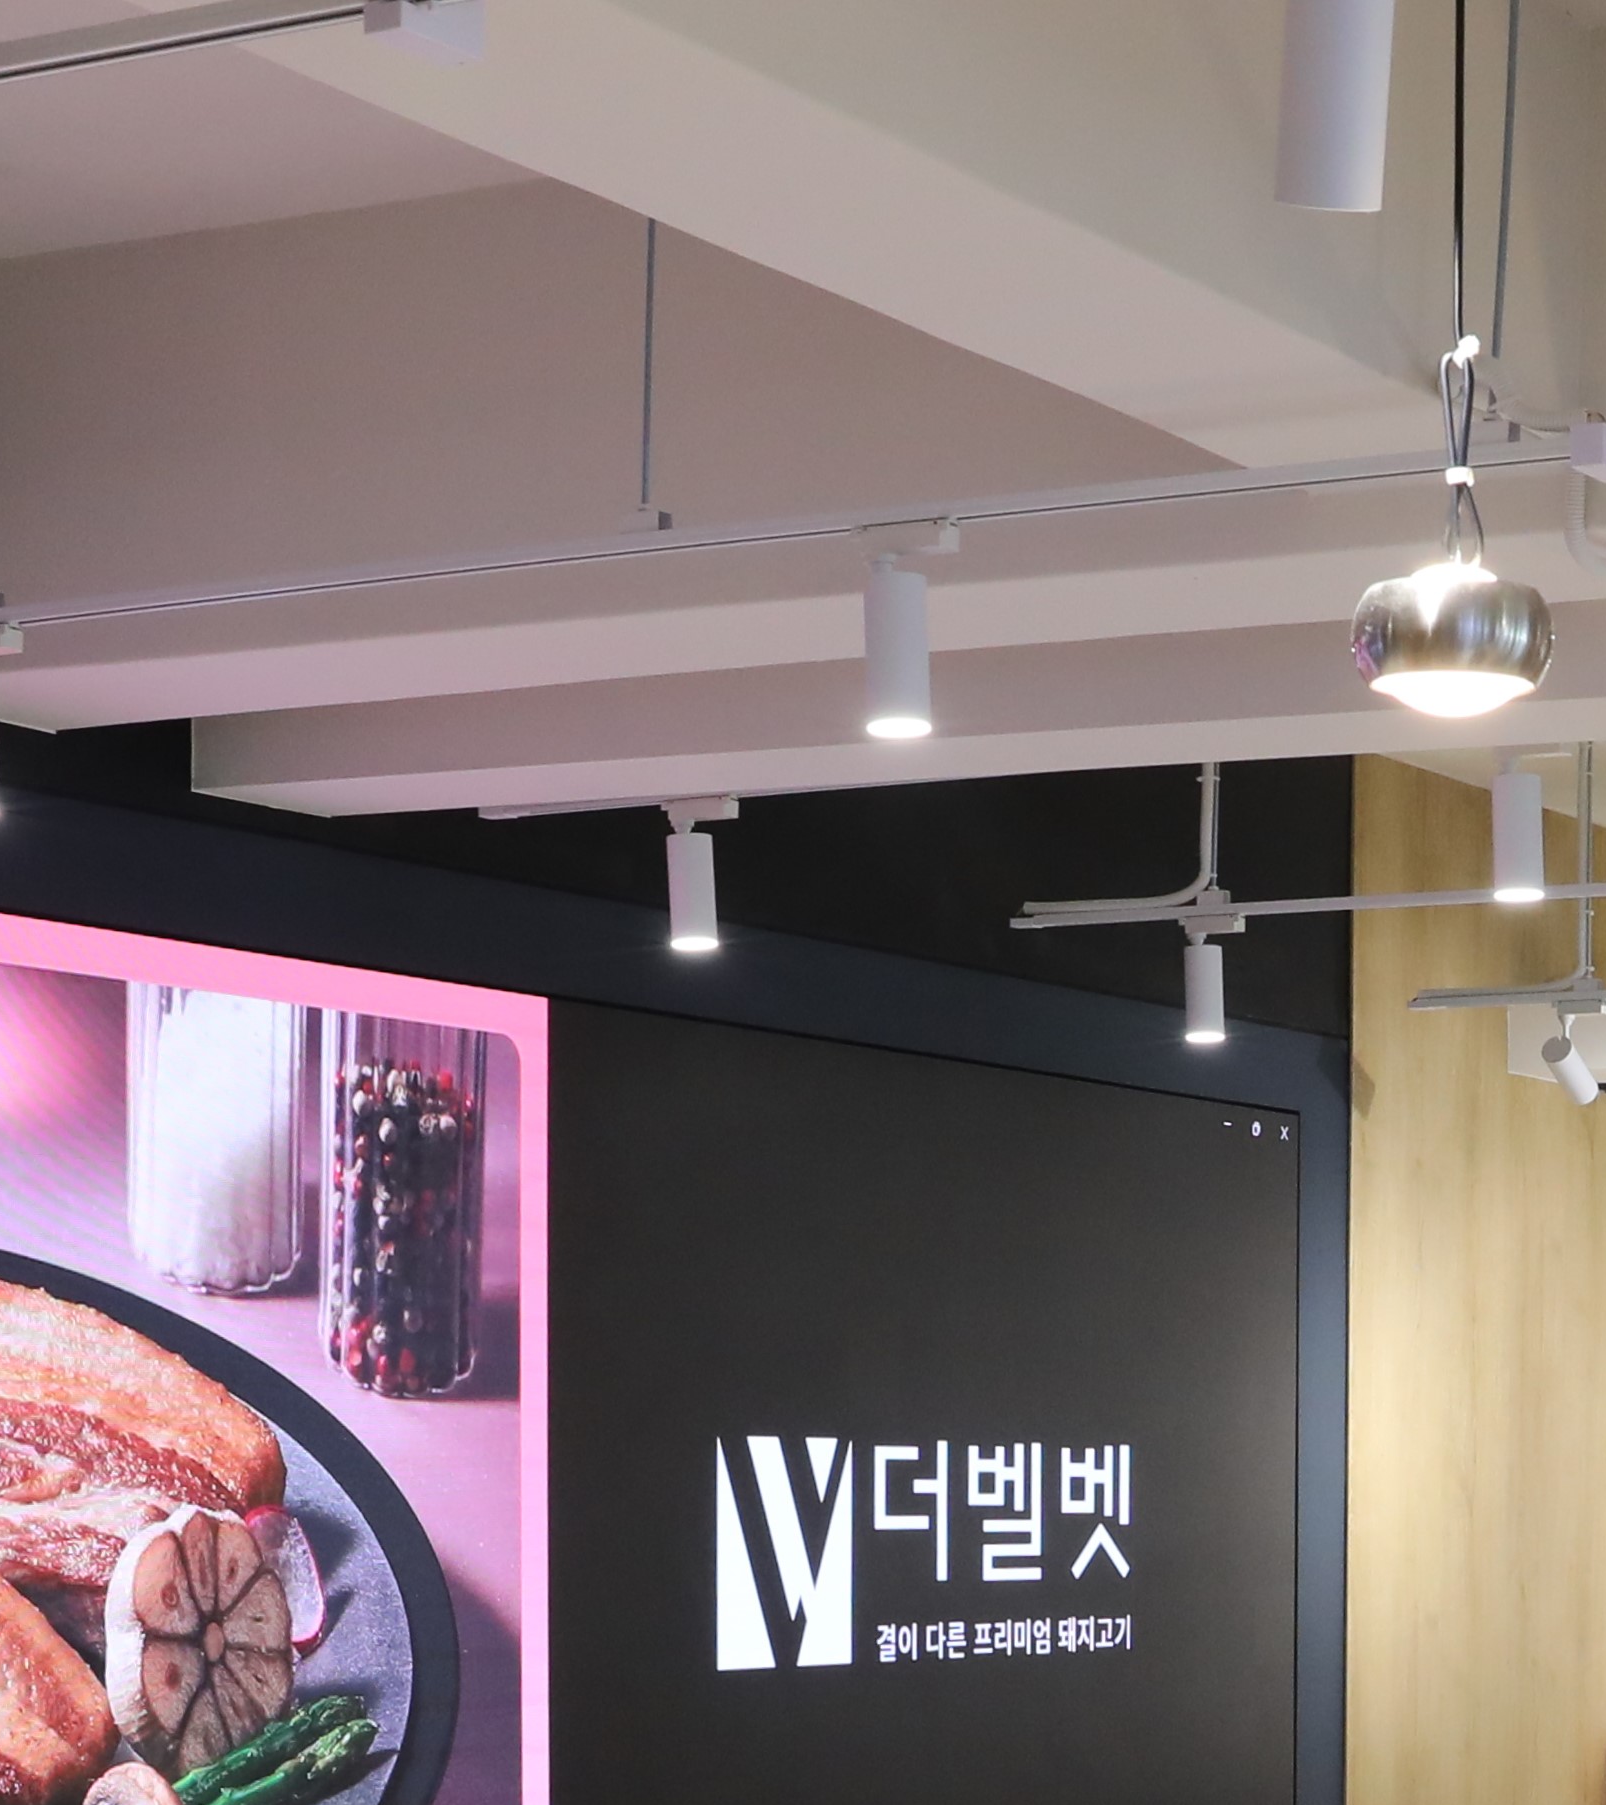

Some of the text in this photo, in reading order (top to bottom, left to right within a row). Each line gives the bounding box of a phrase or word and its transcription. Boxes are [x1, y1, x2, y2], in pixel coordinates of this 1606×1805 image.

[873, 1440, 1131, 1582] 더벨벳
[876, 1613, 1131, 1663] 결이 다른 프리미엄 돼지고기
